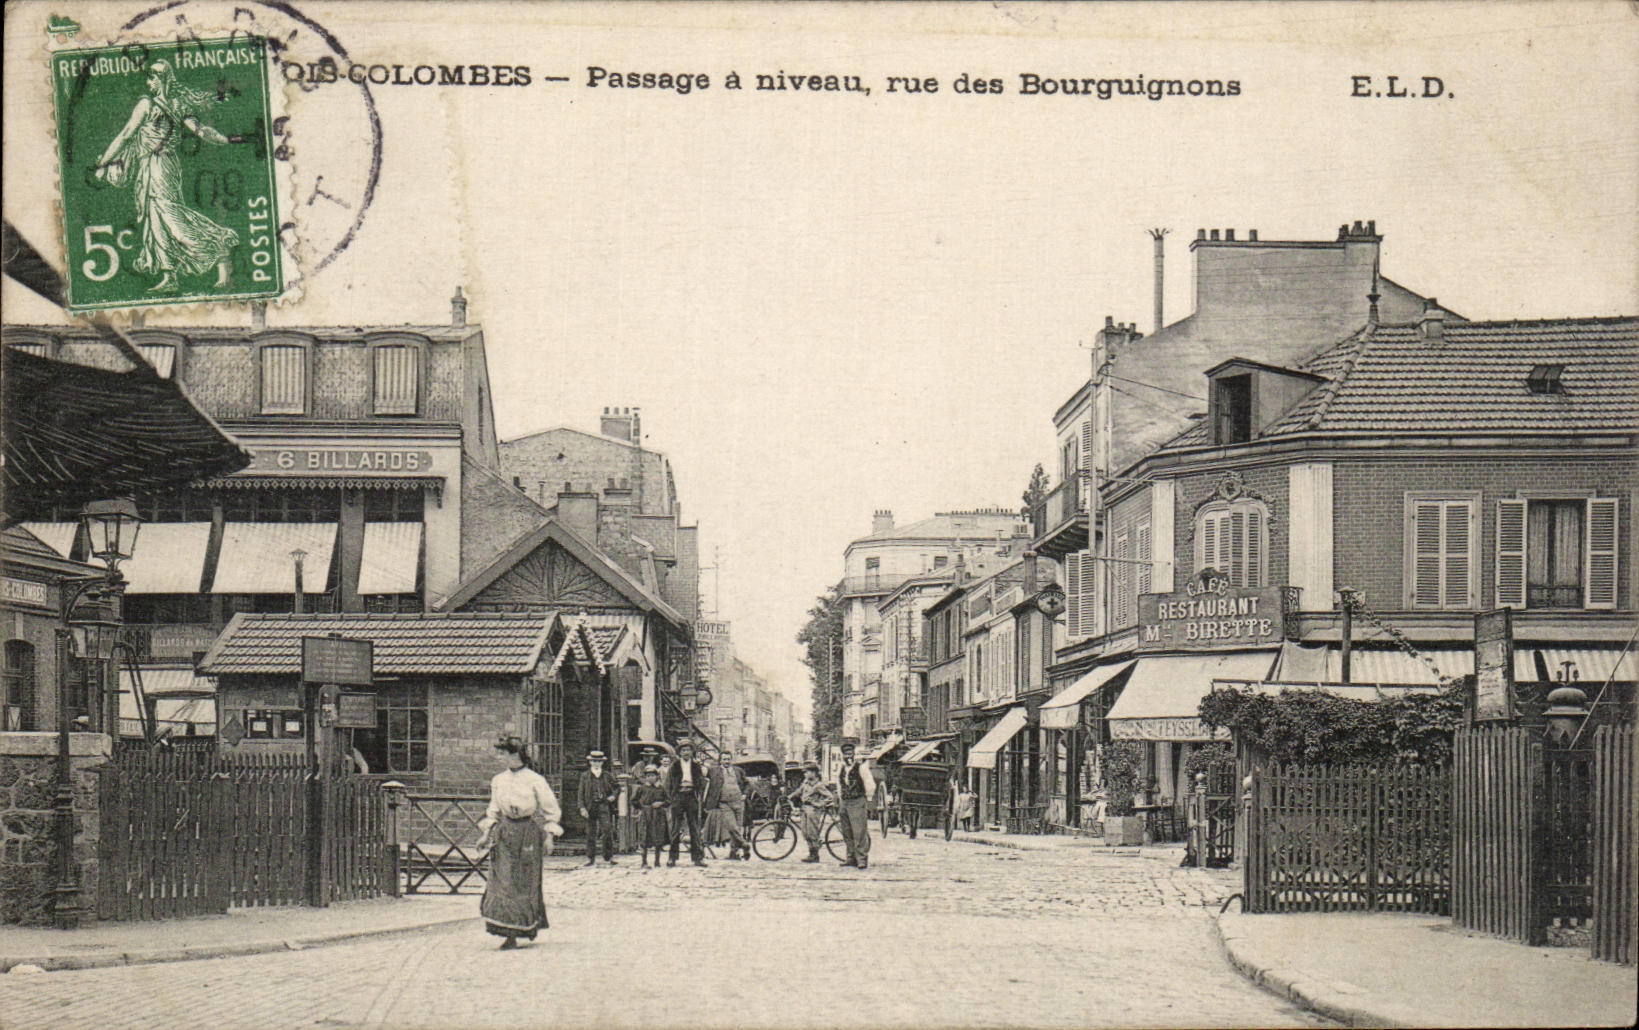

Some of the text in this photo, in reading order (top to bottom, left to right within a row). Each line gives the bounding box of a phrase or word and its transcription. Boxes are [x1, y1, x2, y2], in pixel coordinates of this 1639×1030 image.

[248, 195, 272, 282] POSTES
[277, 451, 296, 468] 6
[308, 451, 418, 470] BILLARDS
[1158, 597, 1259, 619] RESTAURANT
[696, 622, 729, 635] HOTEL
[1186, 618, 1273, 640] BIRETTE
